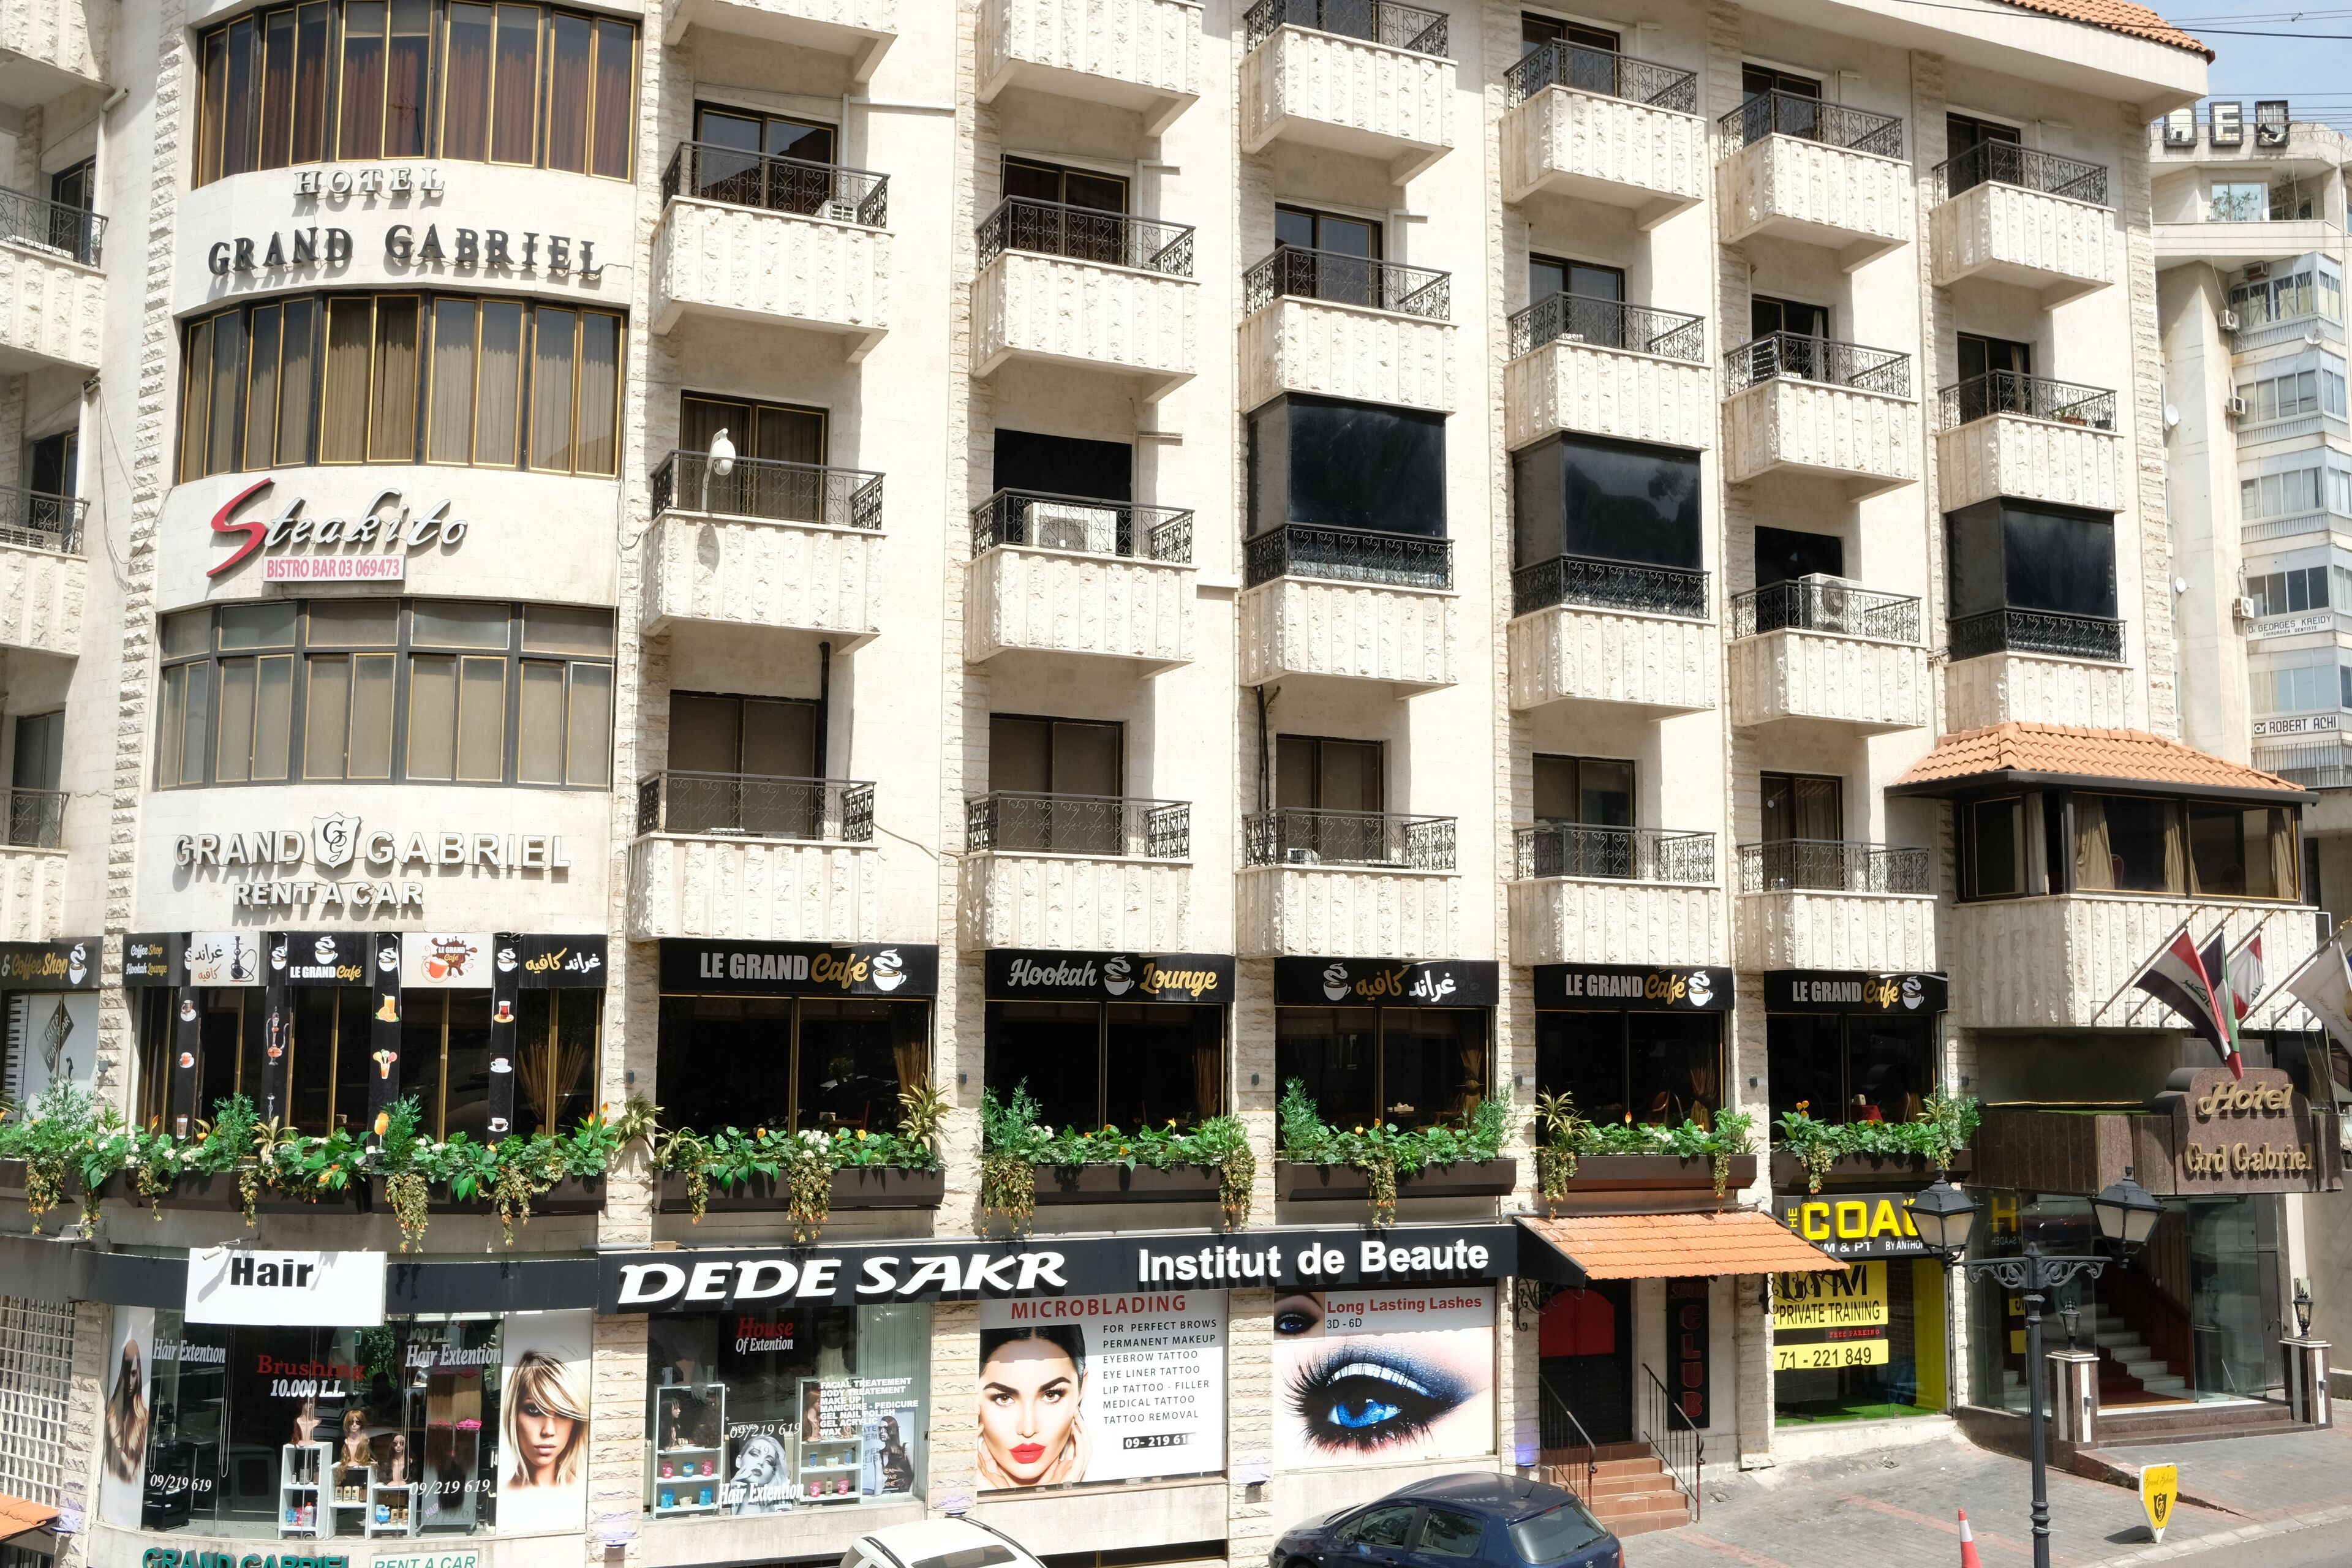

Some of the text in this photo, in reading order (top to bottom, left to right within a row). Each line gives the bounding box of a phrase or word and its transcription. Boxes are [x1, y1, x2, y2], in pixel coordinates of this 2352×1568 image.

[294, 167, 445, 197] HOTEL
[208, 224, 605, 276] GRAND GABRIEL
[206, 477, 468, 578] Steakito
[267, 558, 400, 578] BISTRO BAR 03 069473
[2258, 620, 2296, 632] GEORGES
[2269, 716, 2336, 734] ROBERT ACHI
[173, 831, 305, 867] GRAND
[366, 831, 571, 868] GABRIEL
[233, 881, 424, 906] RENT A CAR
[130, 944, 163, 958] Coffee Shop
[195, 943, 224, 964] غراند
[526, 947, 601, 974] غراند كافيه
[1, 952, 68, 980] & Coffee Shop
[126, 962, 167, 976] Hookah Lounge
[198, 963, 222, 982] كافيه
[290, 965, 363, 981] LE GRAND Café
[700, 952, 871, 990] LE GRAND Café
[1007, 959, 1218, 997] Hookah Lounge
[1356, 964, 1457, 1003] غراند كافيه
[1566, 973, 1687, 1005] LE GRAND Café
[1793, 979, 1899, 1009] LE GRAND Café
[2196, 1082, 2293, 1115] Hotel
[2185, 1143, 2313, 1173] Grd Gabriel
[1839, 1243, 1850, 1253] &
[1854, 1242, 1872, 1252] PT
[1885, 1241, 1895, 1251] BY
[1139, 1239, 1488, 1282] Institut de Beaute
[230, 1257, 314, 1287] Hair
[618, 1251, 1068, 1305] DEDE SAKR
[1011, 1295, 1186, 1319] MICROBLADING
[1327, 1296, 1482, 1315] Long Lasting Lashes
[1780, 1303, 1825, 1325] PRIVATE
[1828, 1300, 1880, 1322] TRAINING
[736, 1317, 794, 1338] House
[1103, 1319, 1216, 1333] FOR PERFECT BROWS
[1327, 1319, 1340, 1329] 3D
[1349, 1318, 1362, 1328] 6D
[153, 1338, 226, 1363] Hair Extention
[736, 1336, 793, 1355] Of Extention
[1103, 1334, 1215, 1348] PERMANENT MAKEUP
[405, 1343, 502, 1367] Hair Extention
[1104, 1351, 1198, 1363] EYEBROW TATTOO
[1680, 1304, 1703, 1417] CLUB
[1780, 1351, 1795, 1369] 71
[1813, 1349, 1838, 1367] 221
[1845, 1347, 1871, 1365] 849
[257, 1355, 366, 1381] Brushing
[1104, 1365, 1200, 1379] EYE LINER TATTOO
[270, 1379, 345, 1398] 10.000 L.L.
[820, 1378, 912, 1389] FACIAL TREATEMENT
[820, 1386, 906, 1398] BODY TREATEMENT
[1103, 1385, 1119, 1395] LIP
[1123, 1383, 1164, 1393] TATTOO
[1175, 1380, 1210, 1390] FILLER
[820, 1403, 867, 1412] MANICURE
[875, 1400, 919, 1409] PEDICURE
[1103, 1395, 1195, 1409] MEDICAL TATTOO
[840, 1417, 878, 1426] ACRYLIC
[862, 1409, 895, 1418] POLISH
[1104, 1410, 1199, 1425] TATTOO REMOVAL
[730, 1424, 774, 1441] 09/219
[778, 1423, 801, 1435] 619
[1148, 1436, 1169, 1447] 219
[150, 1474, 211, 1491] 09/219 619
[410, 1479, 491, 1498] 09/219 619
[717, 1479, 805, 1505] Hair Extention
[424, 1503, 440, 1517] HAIR
